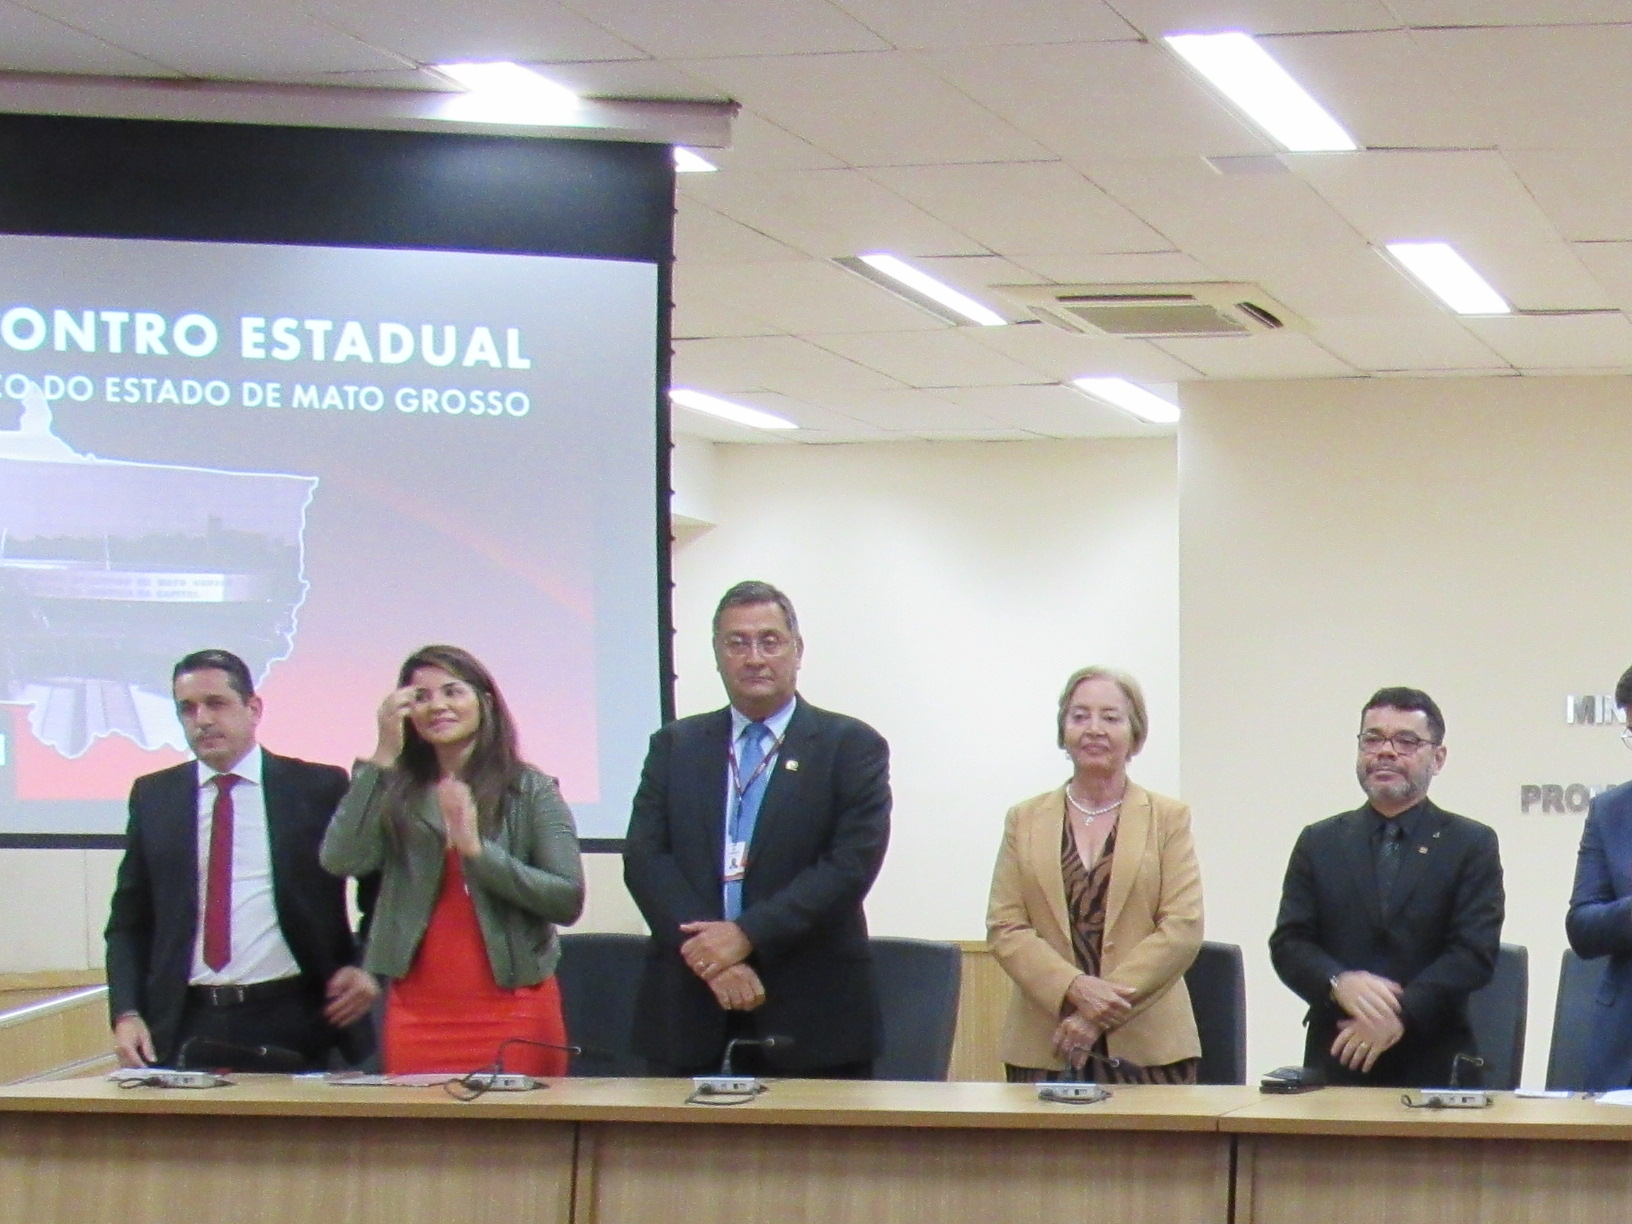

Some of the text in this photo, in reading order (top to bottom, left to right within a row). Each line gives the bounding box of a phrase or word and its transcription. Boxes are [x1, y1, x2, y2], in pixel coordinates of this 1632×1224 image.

[240, 315, 532, 370] ESTADUAL
[0, 372, 531, 417] O DO ESTADO DE MATO GROSSO
